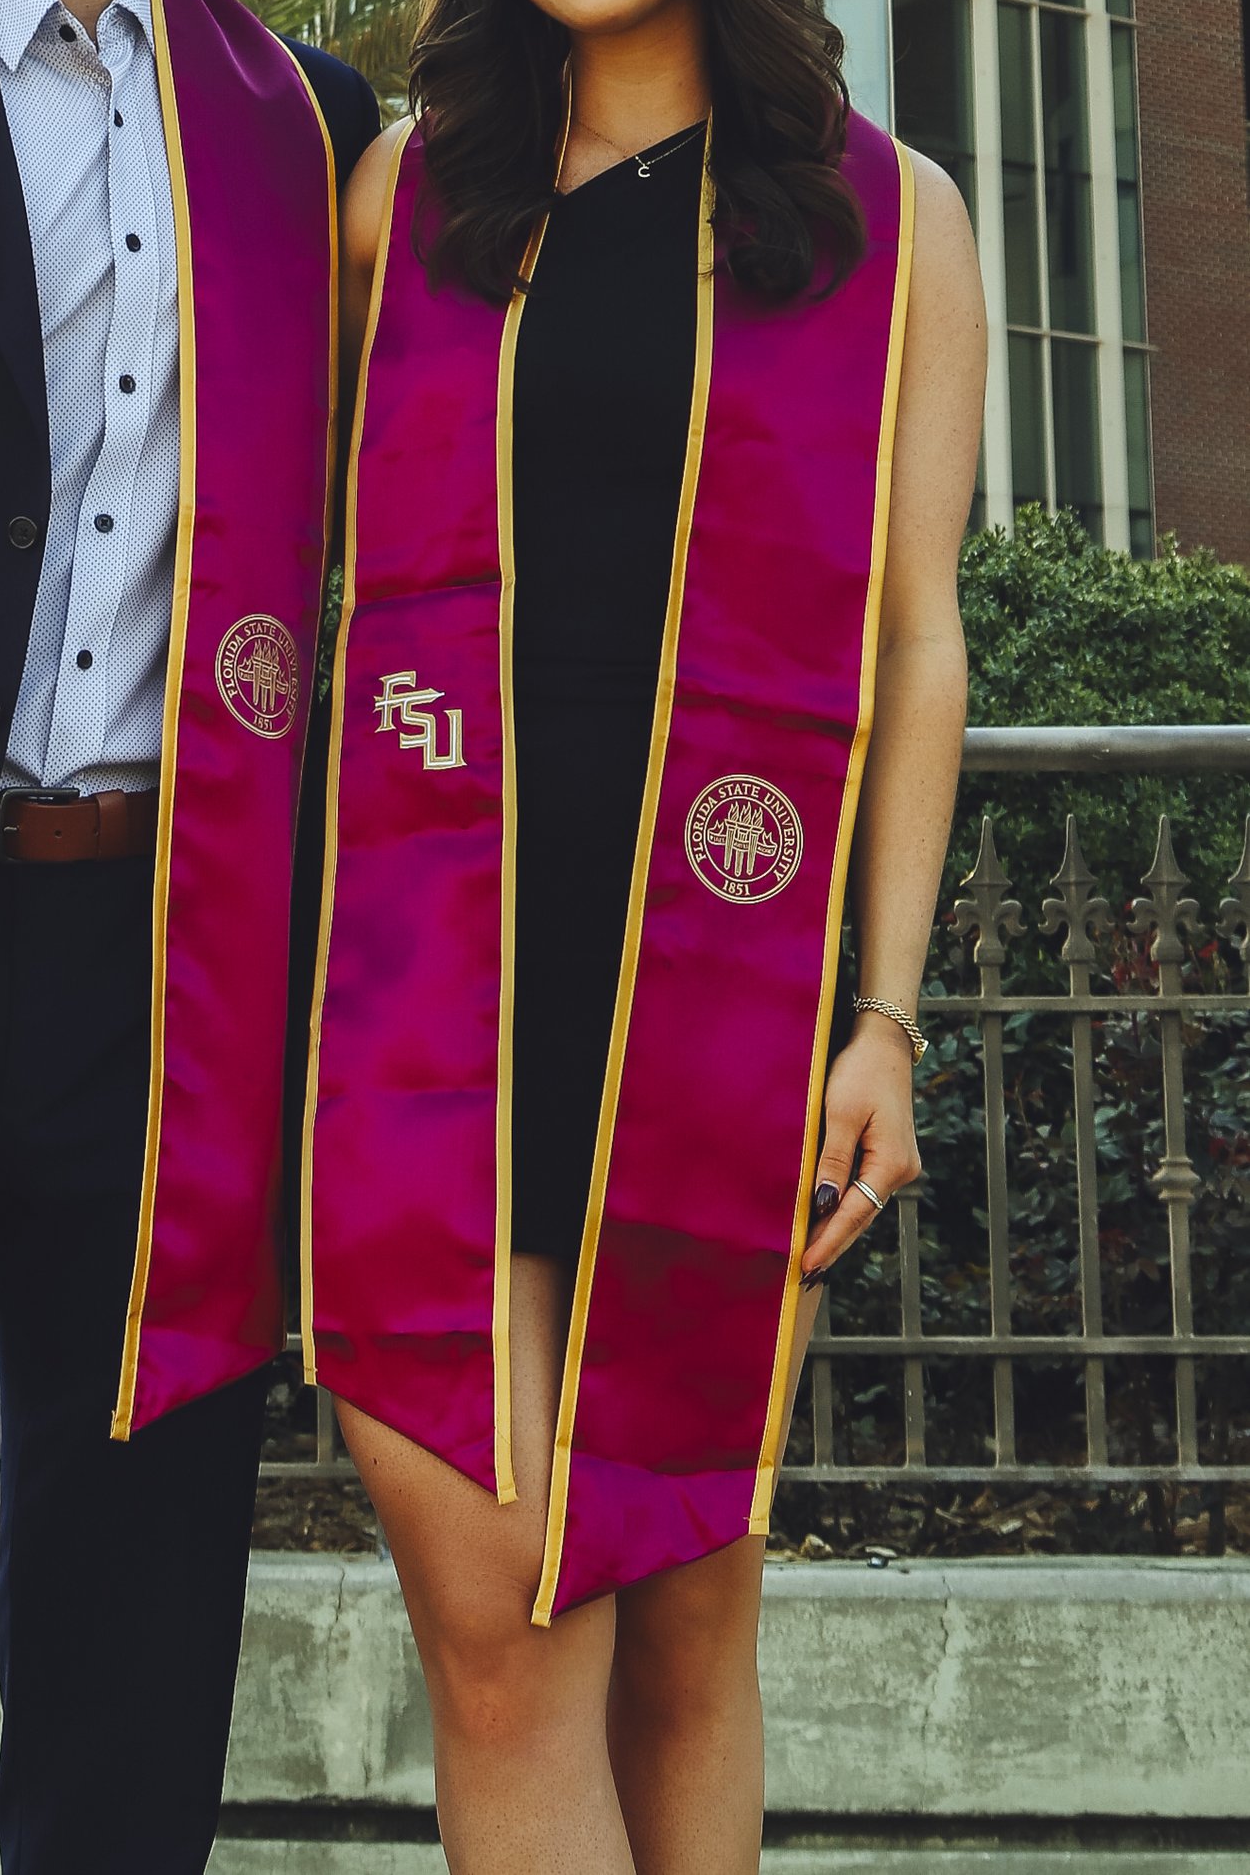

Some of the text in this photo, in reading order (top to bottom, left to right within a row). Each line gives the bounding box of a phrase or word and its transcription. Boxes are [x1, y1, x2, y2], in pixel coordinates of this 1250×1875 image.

[223, 635, 244, 698] FLORIDA
[244, 622, 276, 637] STATE
[253, 714, 273, 730] 1851
[372, 670, 467, 770] FSU
[692, 783, 795, 882] FLORIDA STATE UNIVERSITY
[722, 880, 751, 896] 1851
